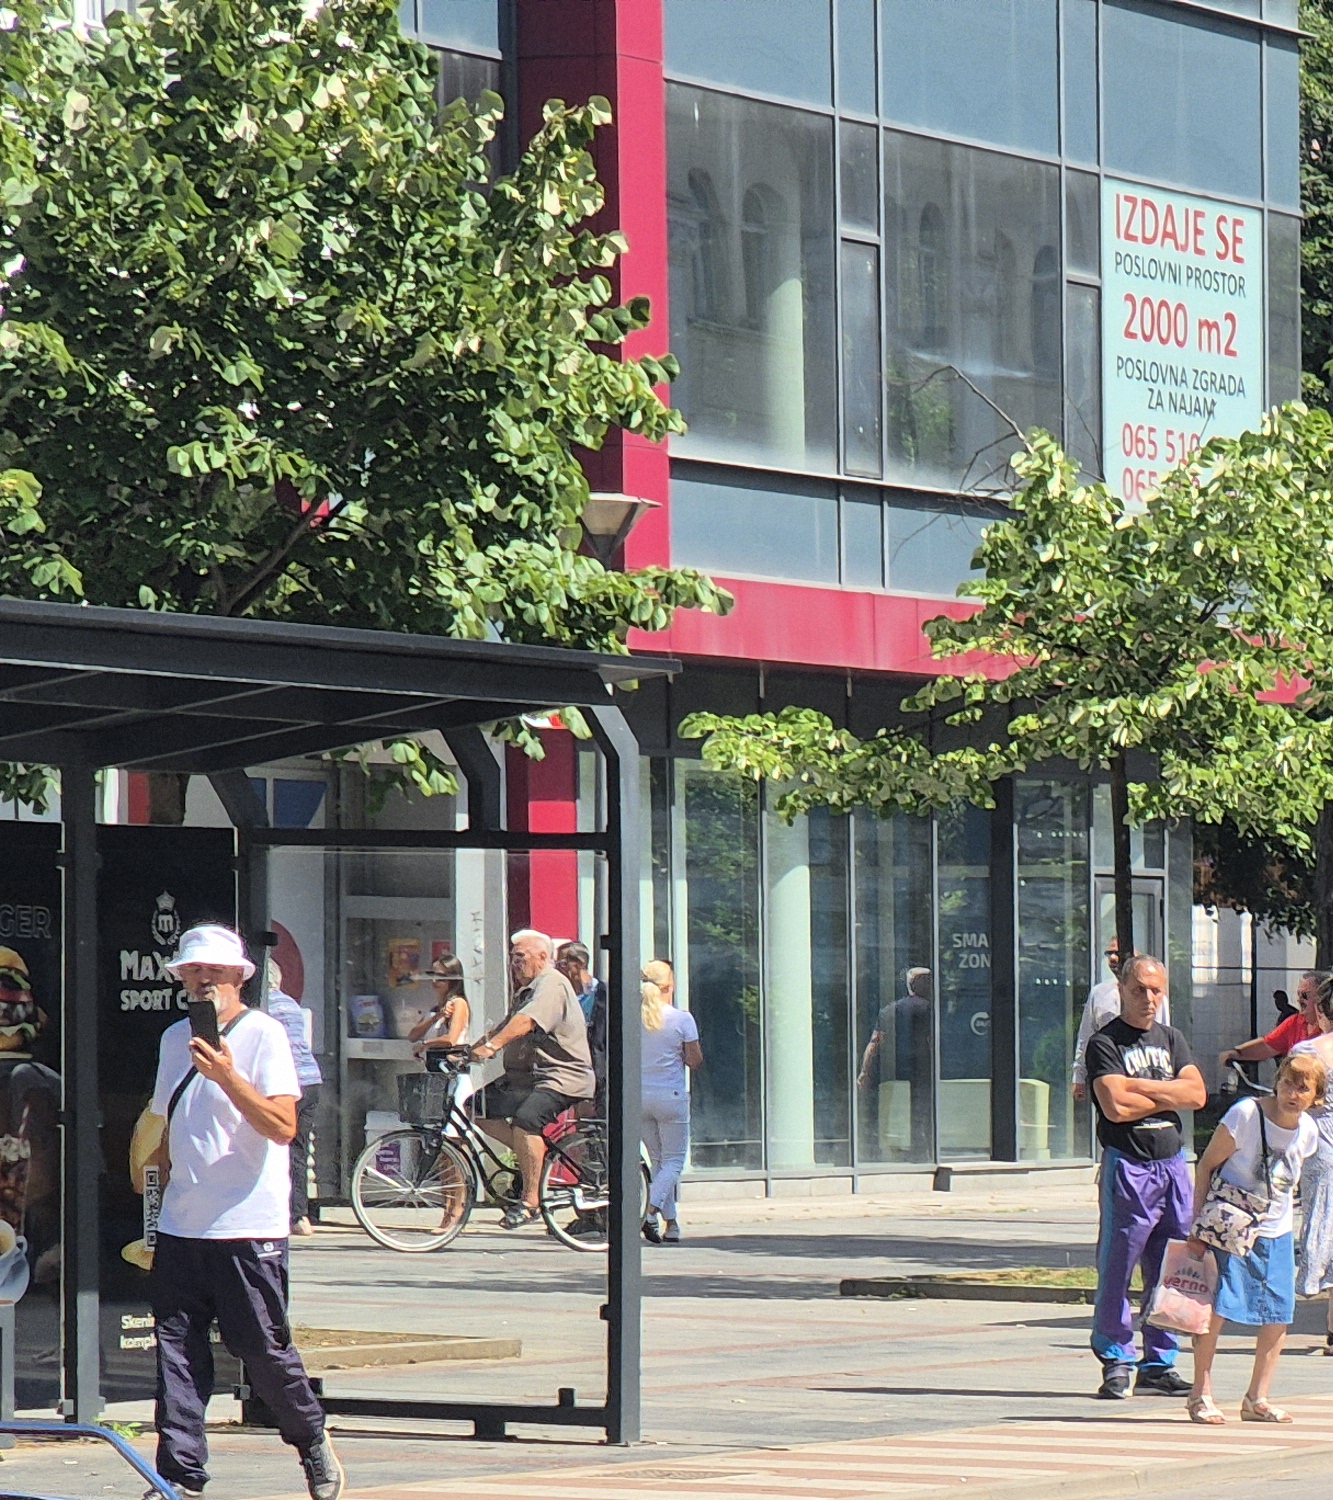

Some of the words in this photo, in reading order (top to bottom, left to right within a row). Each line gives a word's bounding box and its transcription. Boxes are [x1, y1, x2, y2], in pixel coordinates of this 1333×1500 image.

[1115, 193, 1206, 256] IZDAJE
[1215, 214, 1245, 264] SE
[1114, 251, 1182, 286] POSLOVNI
[1186, 265, 1247, 298] PROSTOR
[1123, 293, 1189, 349] 2000
[1197, 312, 1238, 358] m2
[1116, 355, 1188, 388] POSLOVNA
[1192, 369, 1247, 398] ZGRADA
[1147, 387, 1164, 411] ZA
[1168, 392, 1216, 420] NAJAM
[1122, 422, 1158, 462] 065
[952, 932, 990, 948] SMA
[958, 953, 991, 968] ZON
[120, 988, 173, 1011] SPORT
